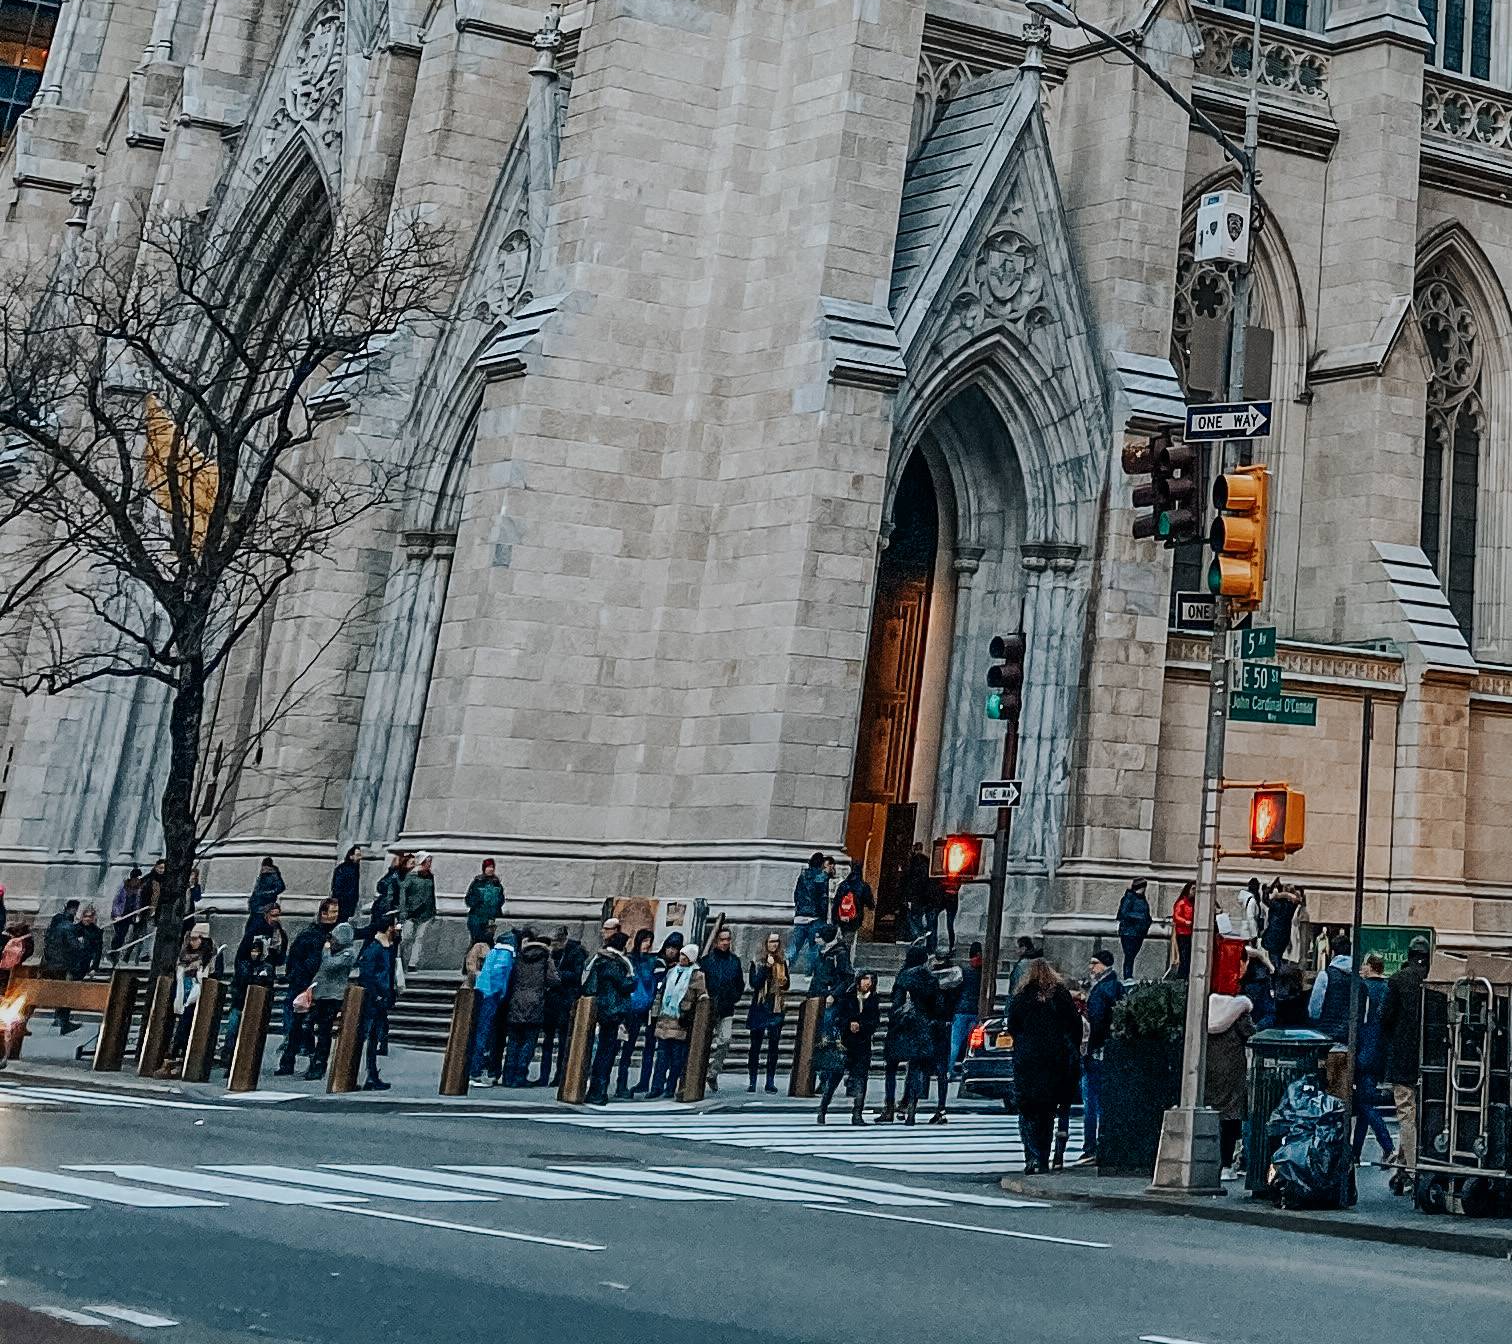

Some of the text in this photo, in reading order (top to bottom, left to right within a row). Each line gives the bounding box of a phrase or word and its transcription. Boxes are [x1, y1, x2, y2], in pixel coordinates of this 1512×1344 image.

[1198, 413, 1259, 430] ONE WAY
[1188, 604, 1210, 619] ONE
[1248, 633, 1255, 655] 5
[1243, 666, 1250, 687] E
[1253, 667, 1268, 689] 50
[1231, 694, 1250, 709] John
[1252, 695, 1281, 712] Cardinal
